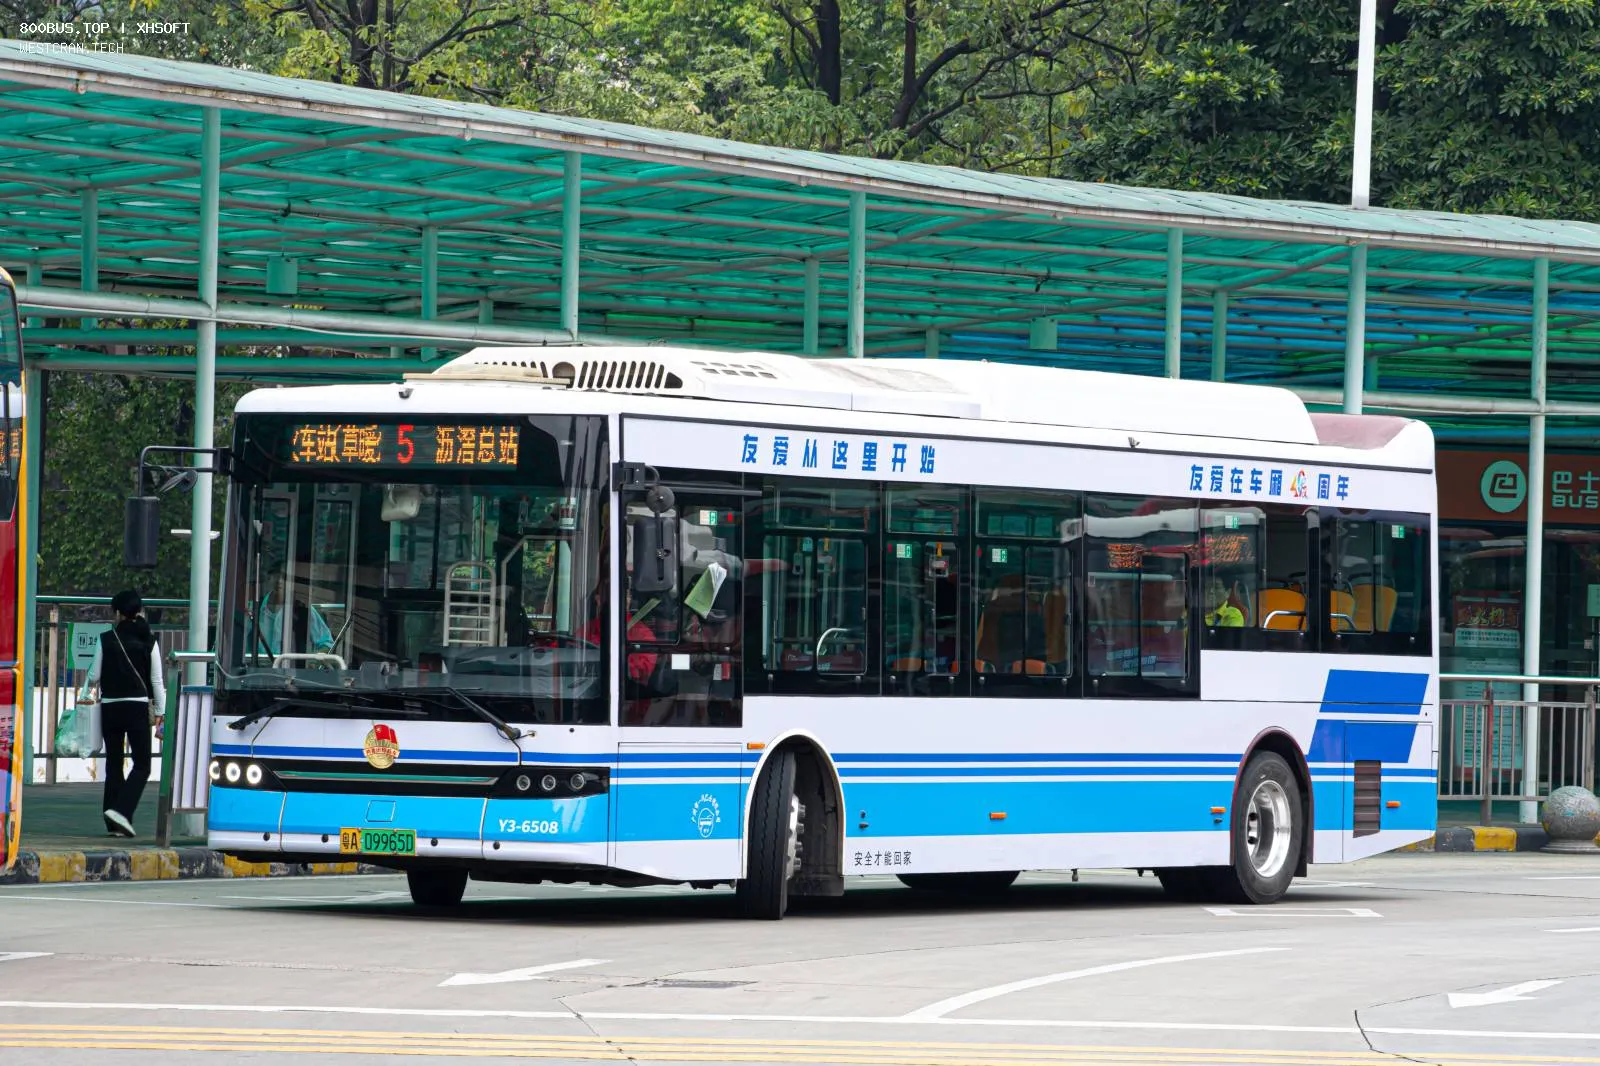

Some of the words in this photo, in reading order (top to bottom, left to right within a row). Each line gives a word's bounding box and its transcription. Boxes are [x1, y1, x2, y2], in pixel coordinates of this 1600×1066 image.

[396, 424, 415, 464] 5
[436, 426, 519, 465] 沥滘总站
[741, 433, 936, 474] 友爱从这里开始
[1551, 470, 1600, 494] 巴士
[1551, 494, 1599, 509] BUS
[498, 818, 559, 834] Y3-6508
[364, 832, 414, 852] 09965D
[854, 850, 912, 867] 安全才能回家
